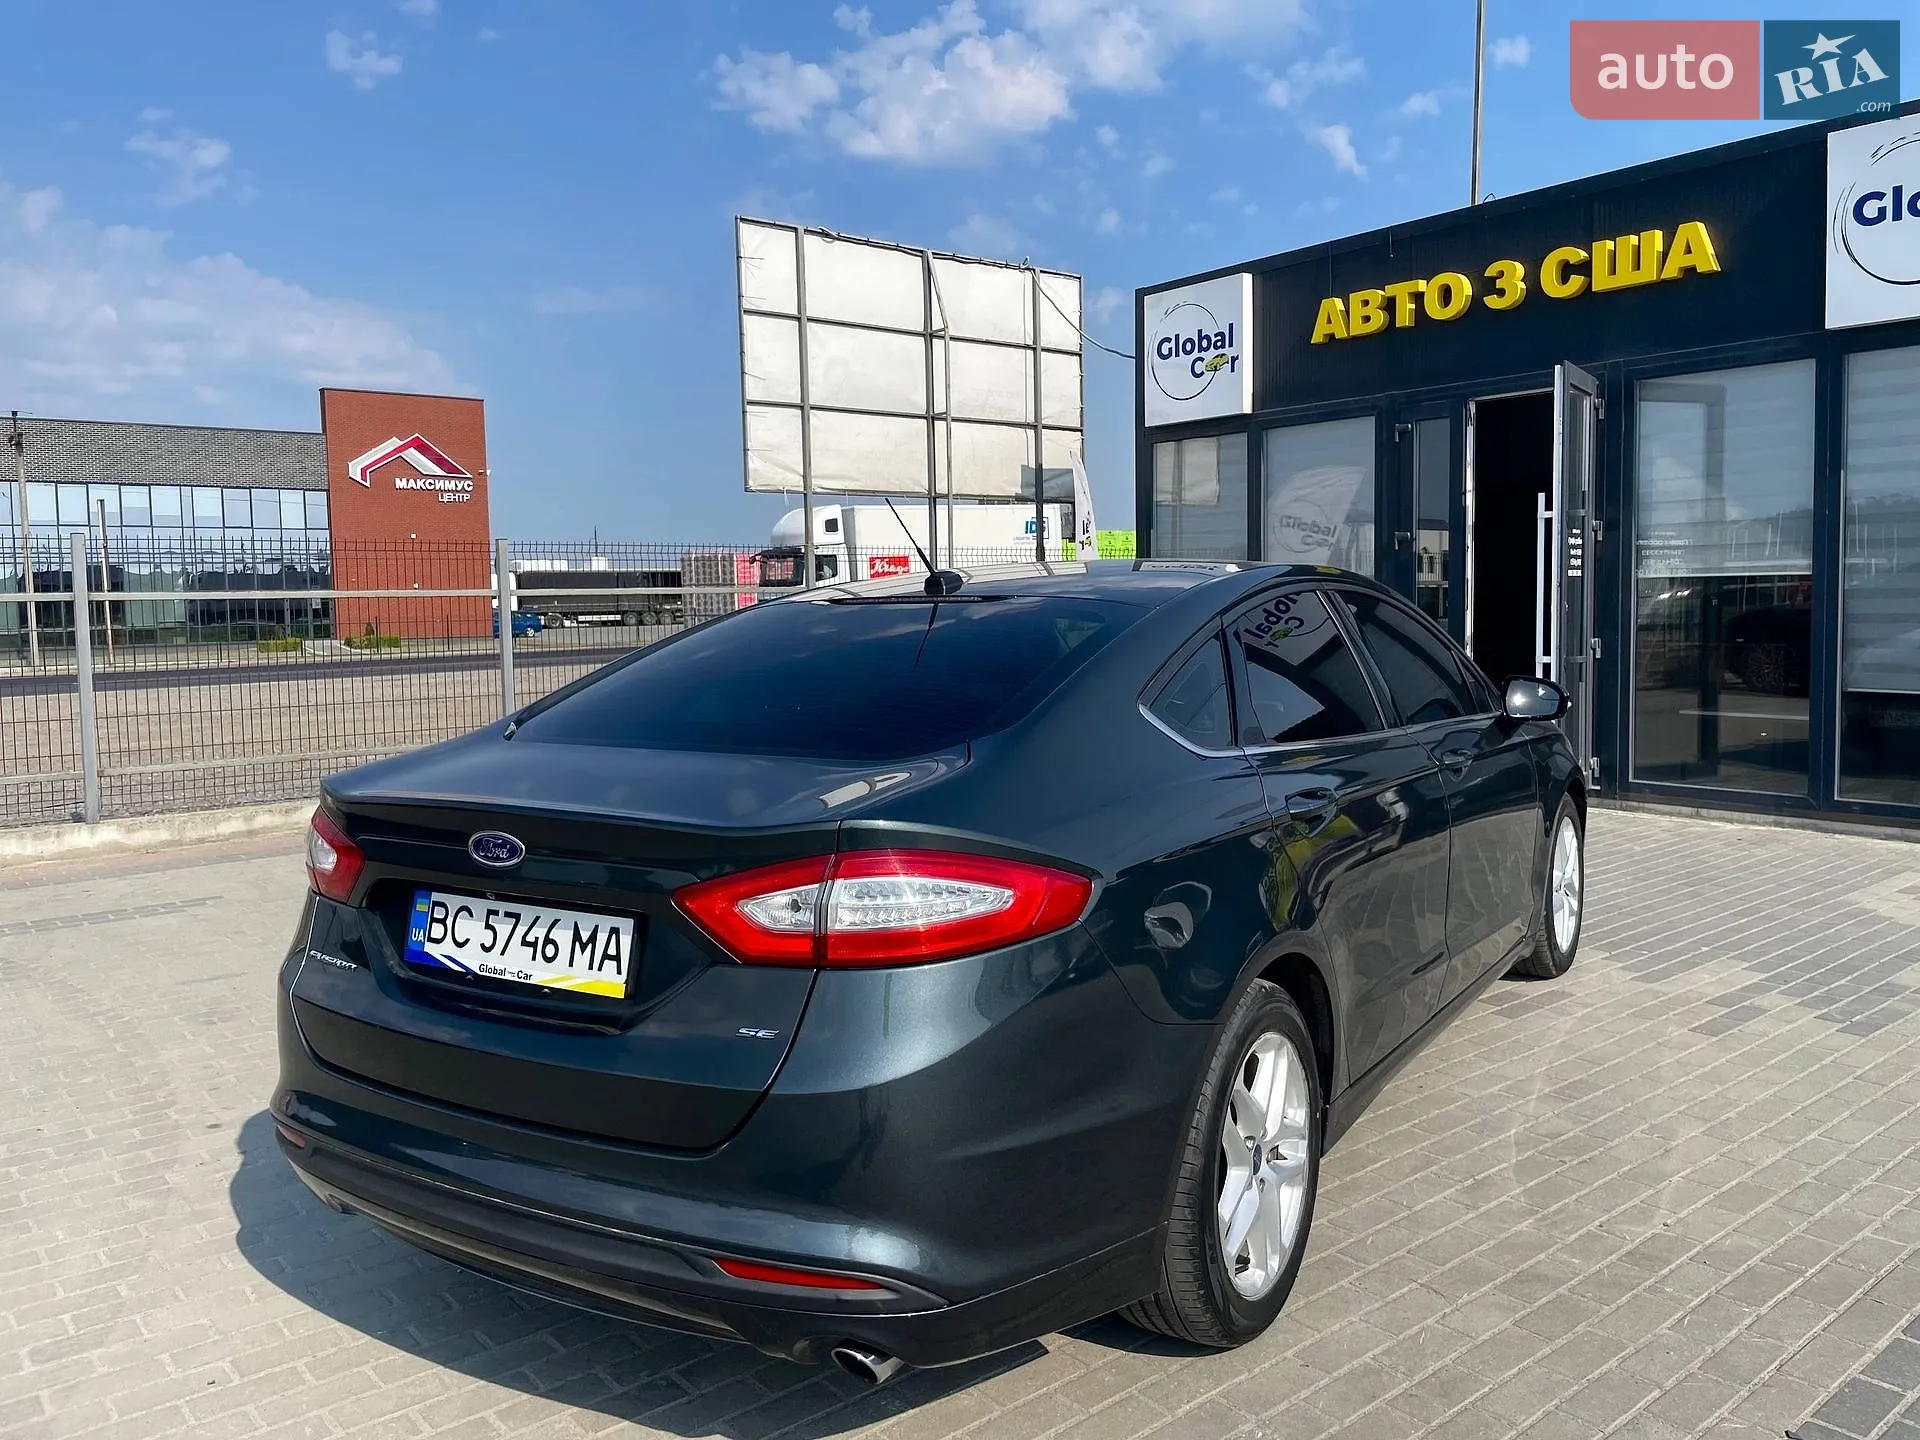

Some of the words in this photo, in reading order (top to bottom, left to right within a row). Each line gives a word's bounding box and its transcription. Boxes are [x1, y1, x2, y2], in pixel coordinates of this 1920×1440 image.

[1310, 270, 1472, 344] АВТО
[1540, 220, 1722, 300] США
[1156, 322, 1234, 361] Global
[394, 477, 474, 492] МАКСИМУС
[438, 492, 471, 504] ЦЕНТР
[478, 837, 511, 859] Ford
[411, 927, 425, 944] UA
[426, 900, 474, 949] BC
[480, 908, 562, 964] 5746
[568, 920, 623, 975] MA
[478, 963, 507, 977] Global
[516, 970, 533, 981] Car
[735, 1027, 780, 1039] SE
